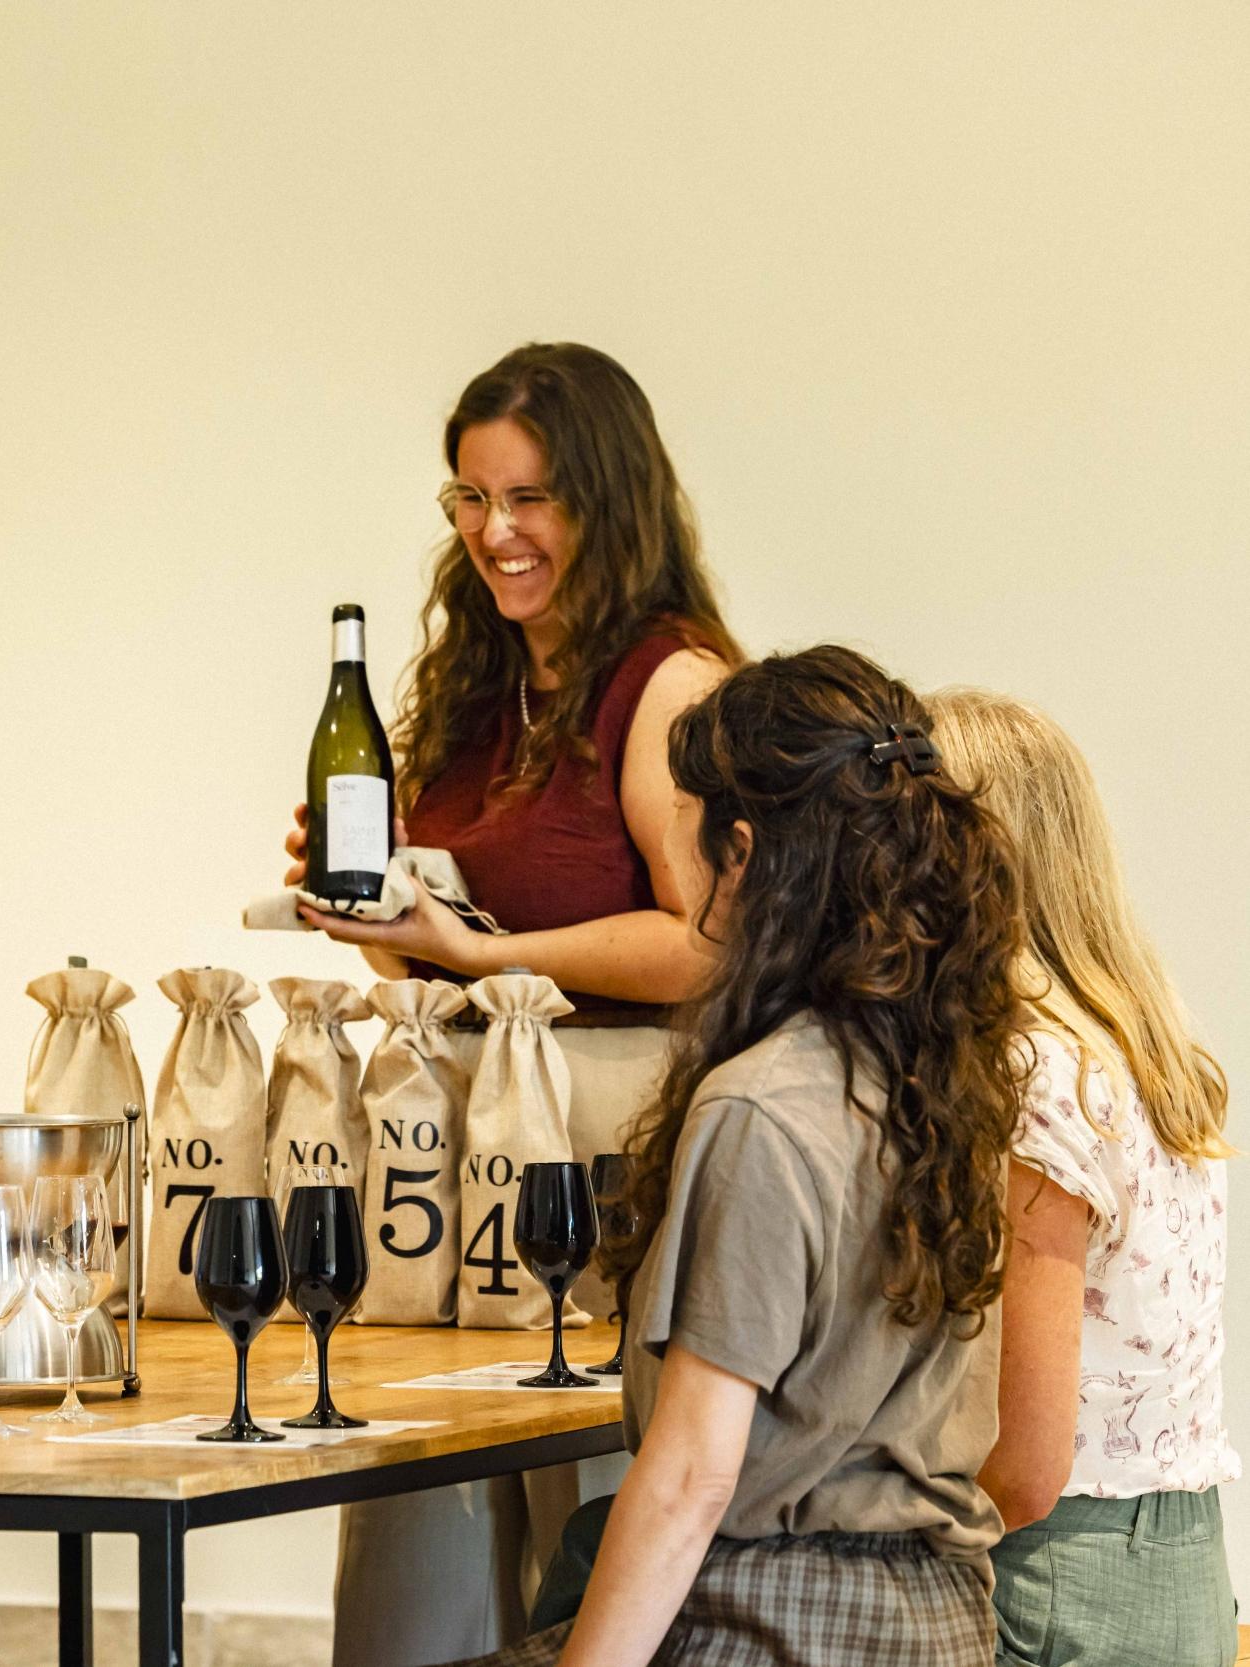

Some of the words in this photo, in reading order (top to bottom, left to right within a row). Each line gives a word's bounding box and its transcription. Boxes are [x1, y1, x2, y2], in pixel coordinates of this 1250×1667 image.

[379, 1119, 447, 1152] NO.
[161, 1137, 223, 1170] NO.
[288, 1140, 348, 1169] NO.
[465, 1153, 523, 1187] NO.
[379, 1165, 445, 1259] 5
[164, 1184, 216, 1276] 7
[463, 1202, 519, 1296] 4
